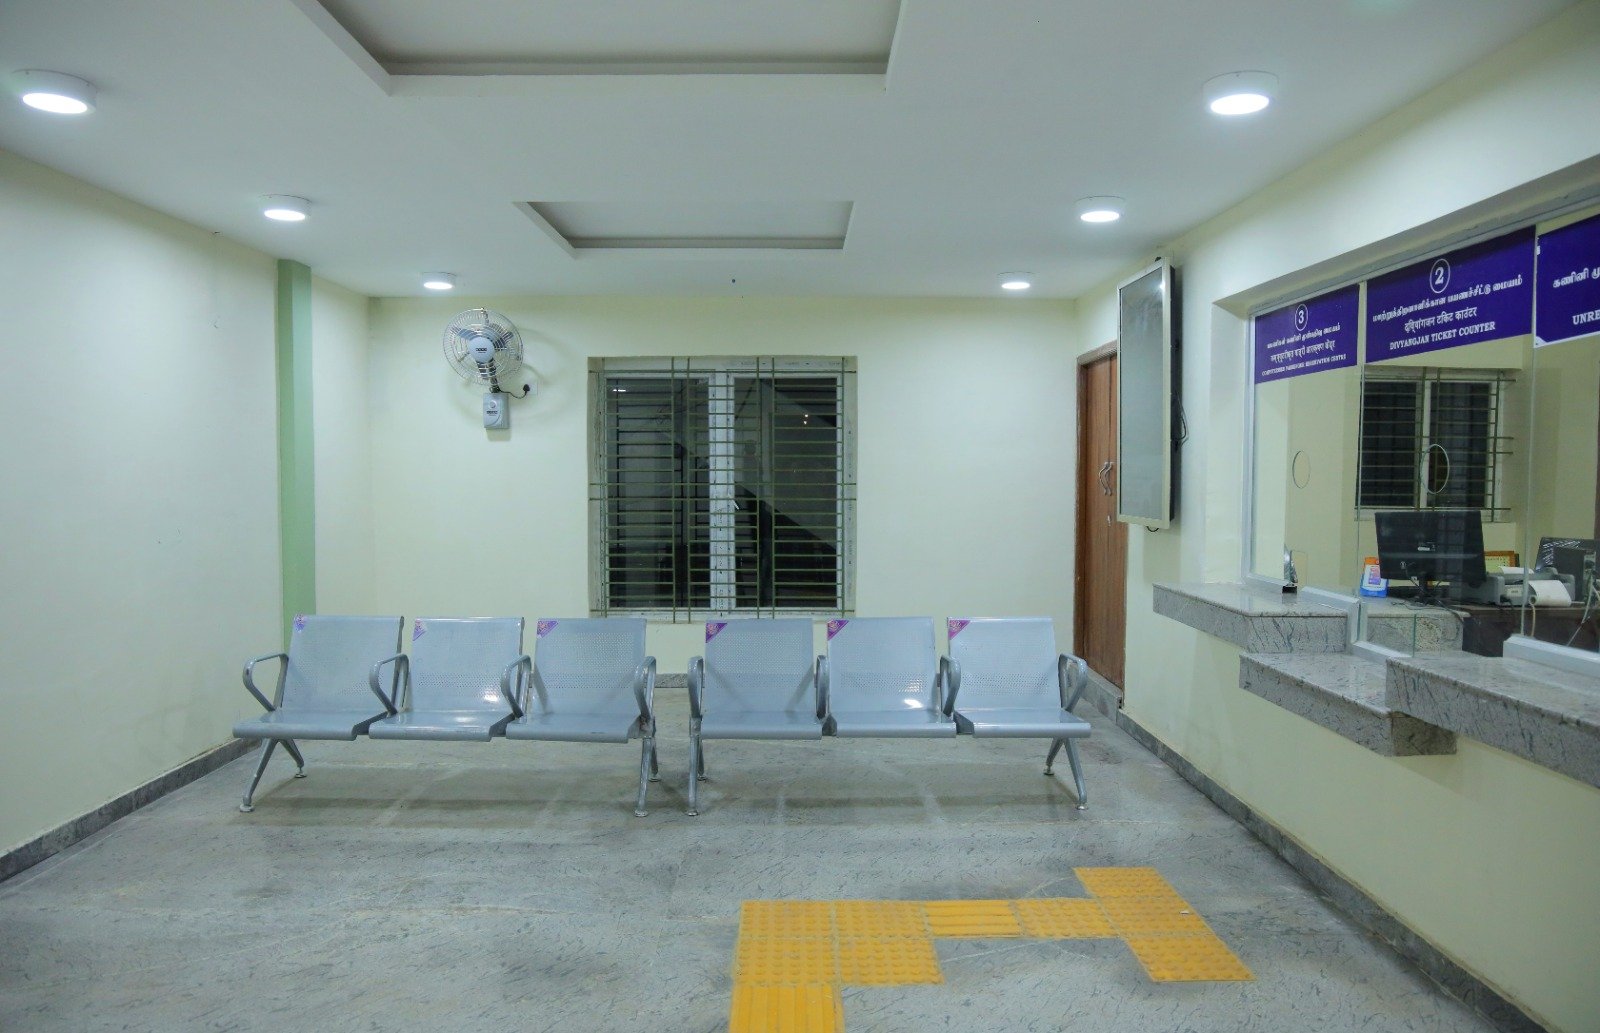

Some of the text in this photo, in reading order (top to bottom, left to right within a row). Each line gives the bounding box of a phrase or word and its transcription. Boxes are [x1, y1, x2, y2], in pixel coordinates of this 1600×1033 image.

[1434, 266, 1444, 285] 2
[1493, 274, 1523, 291] மையம்
[1298, 310, 1305, 324] 3
[1390, 321, 1496, 350] DIVYANGJAN TICKET COUNTER
